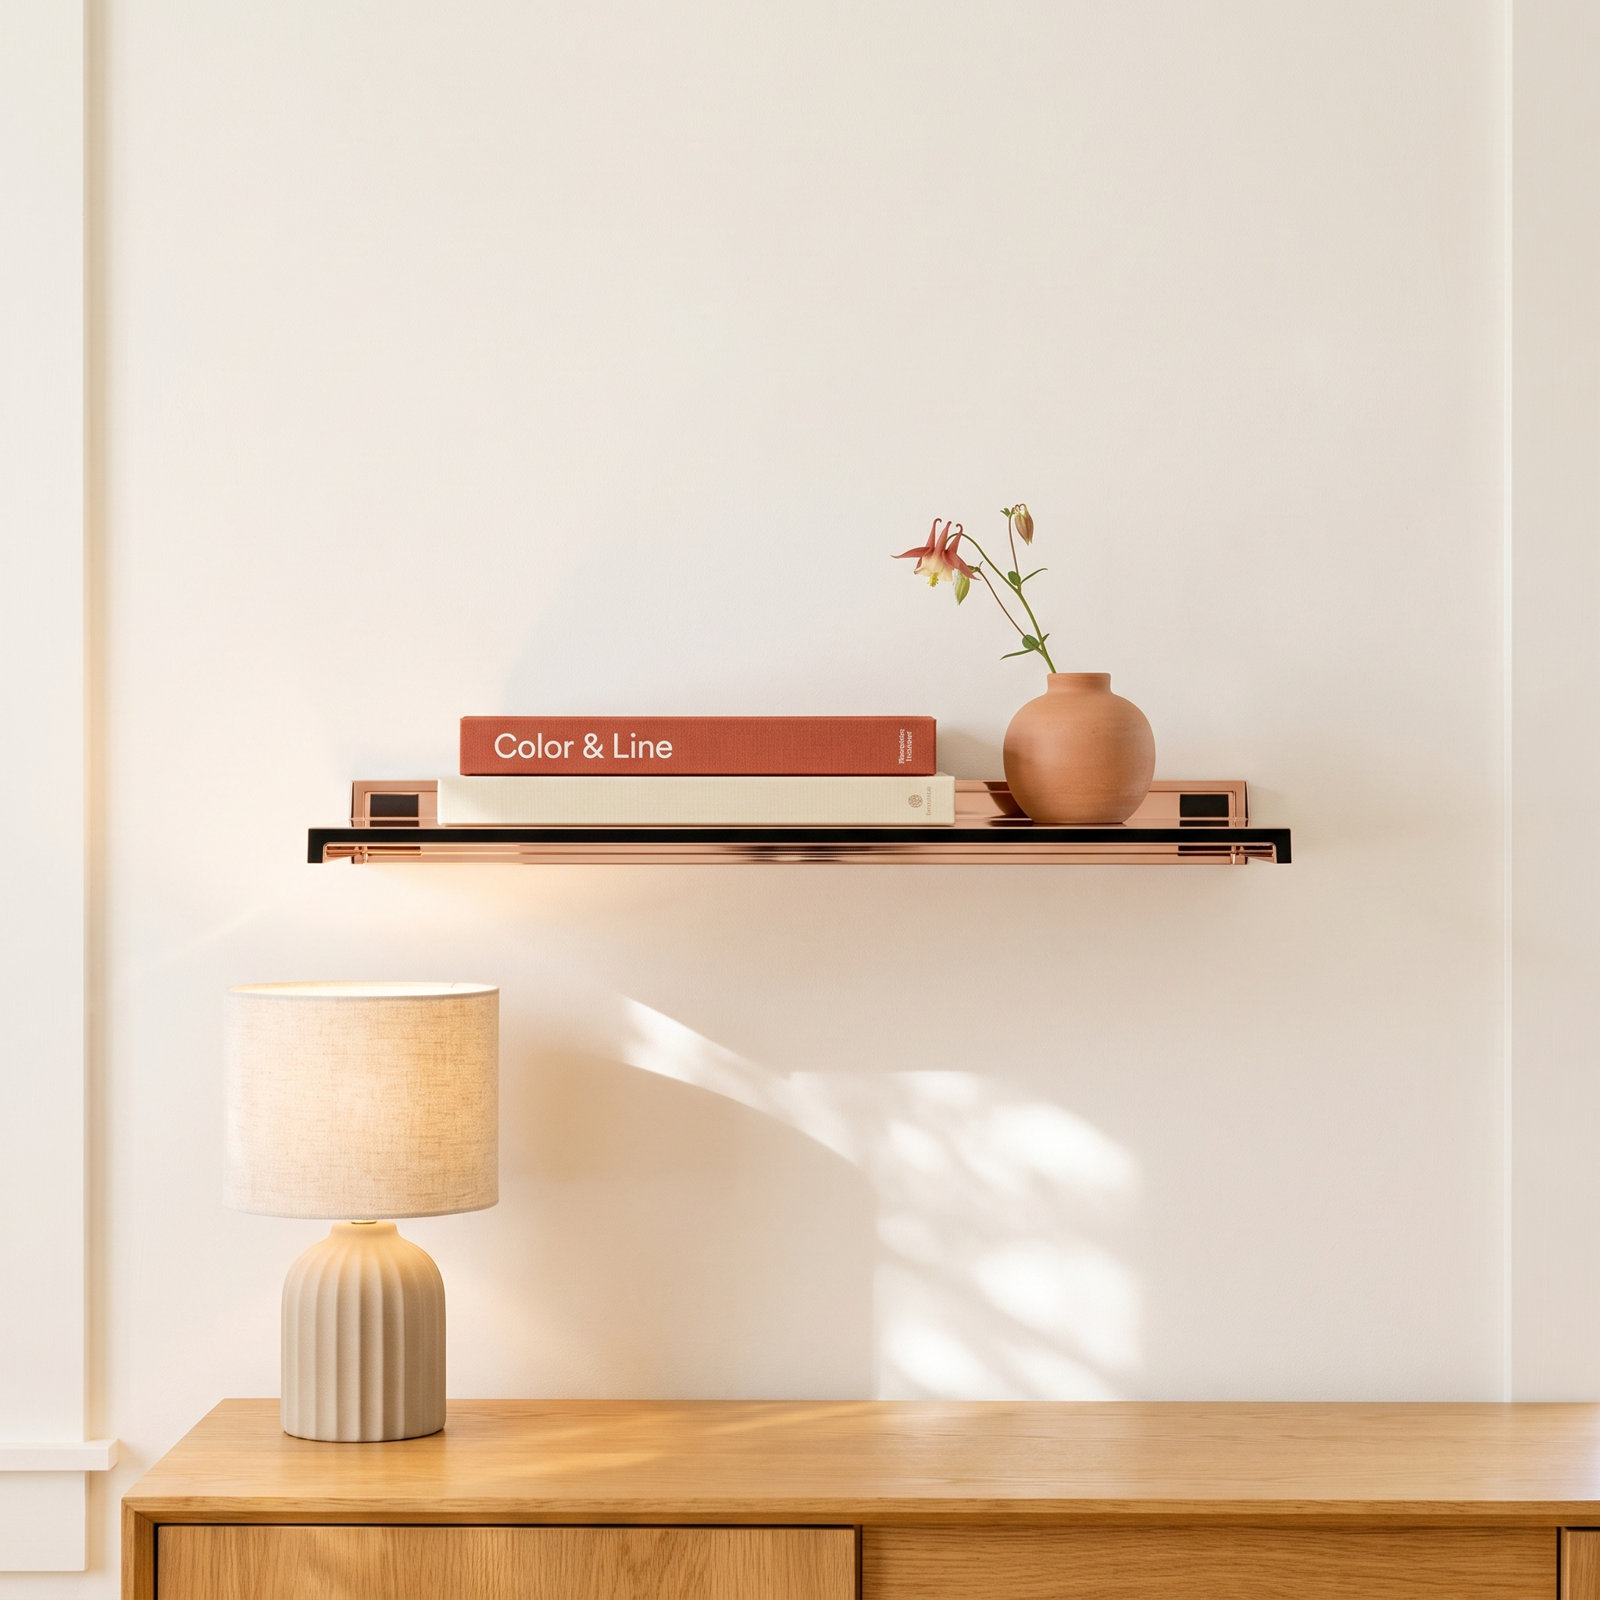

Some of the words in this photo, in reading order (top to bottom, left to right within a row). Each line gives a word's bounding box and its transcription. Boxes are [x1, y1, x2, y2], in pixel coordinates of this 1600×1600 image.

[494, 732, 574, 759] Color
[582, 732, 604, 759] &
[613, 732, 673, 759] Line
